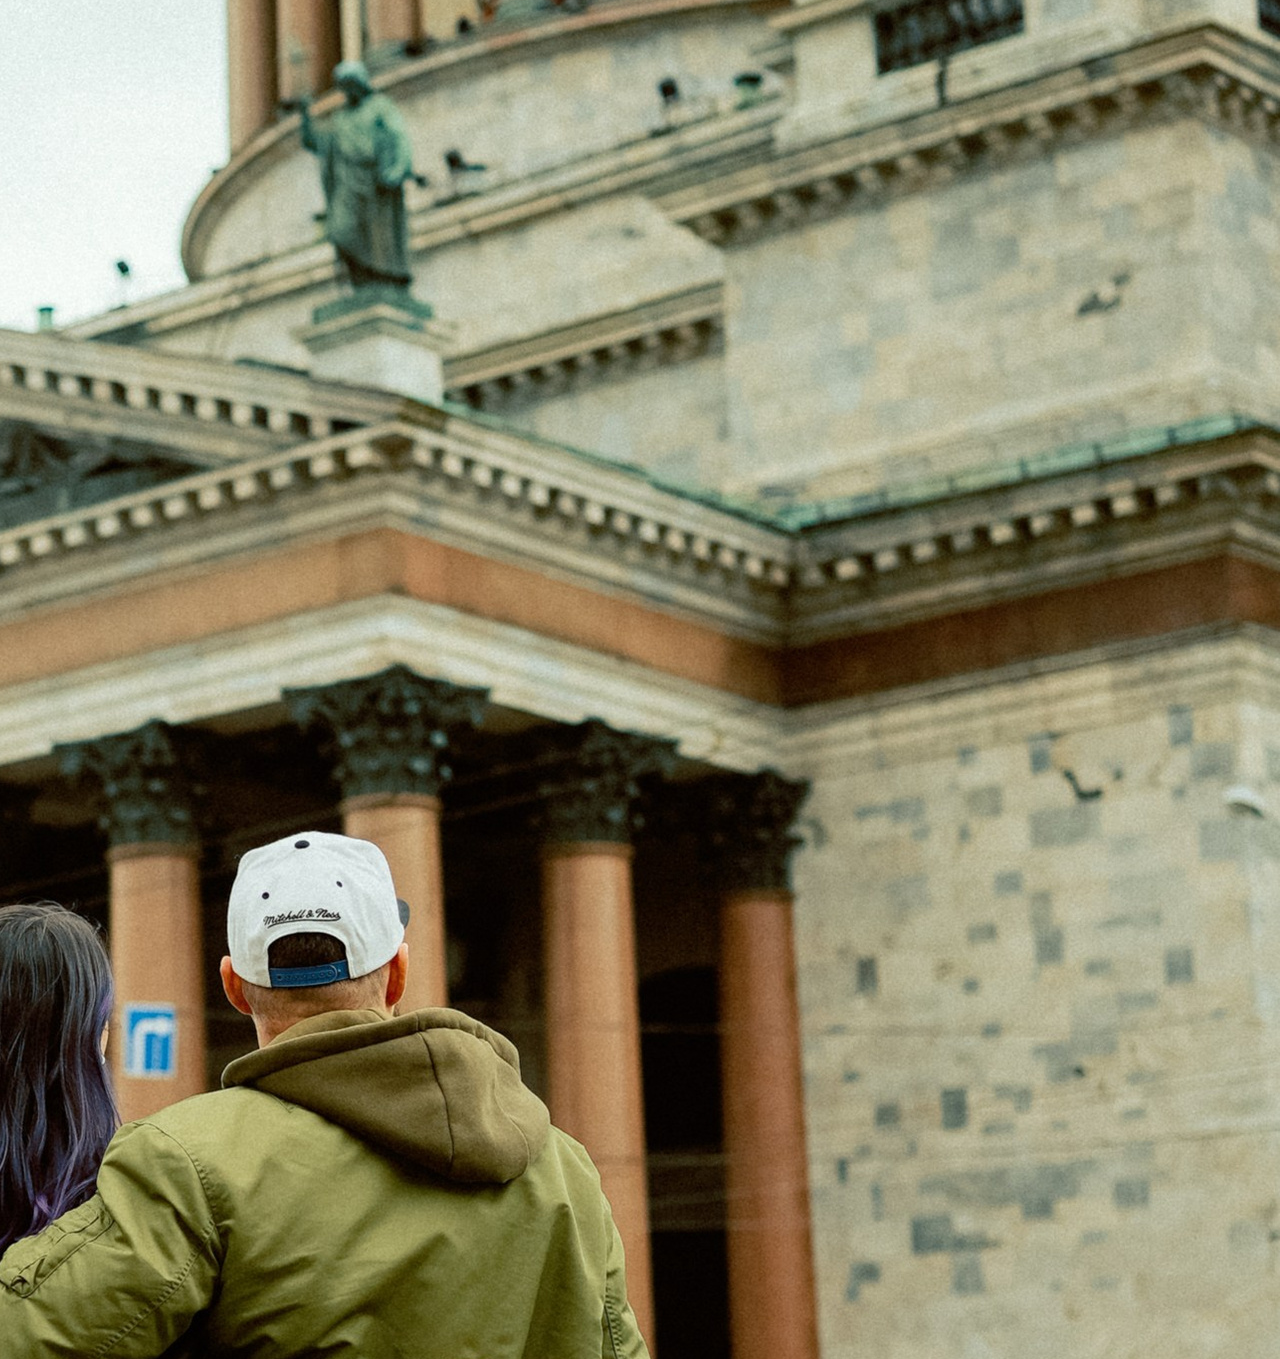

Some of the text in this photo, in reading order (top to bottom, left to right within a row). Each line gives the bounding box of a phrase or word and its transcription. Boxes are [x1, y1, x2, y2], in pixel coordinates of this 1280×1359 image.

[263, 908, 341, 926] Mitchell & Ness
